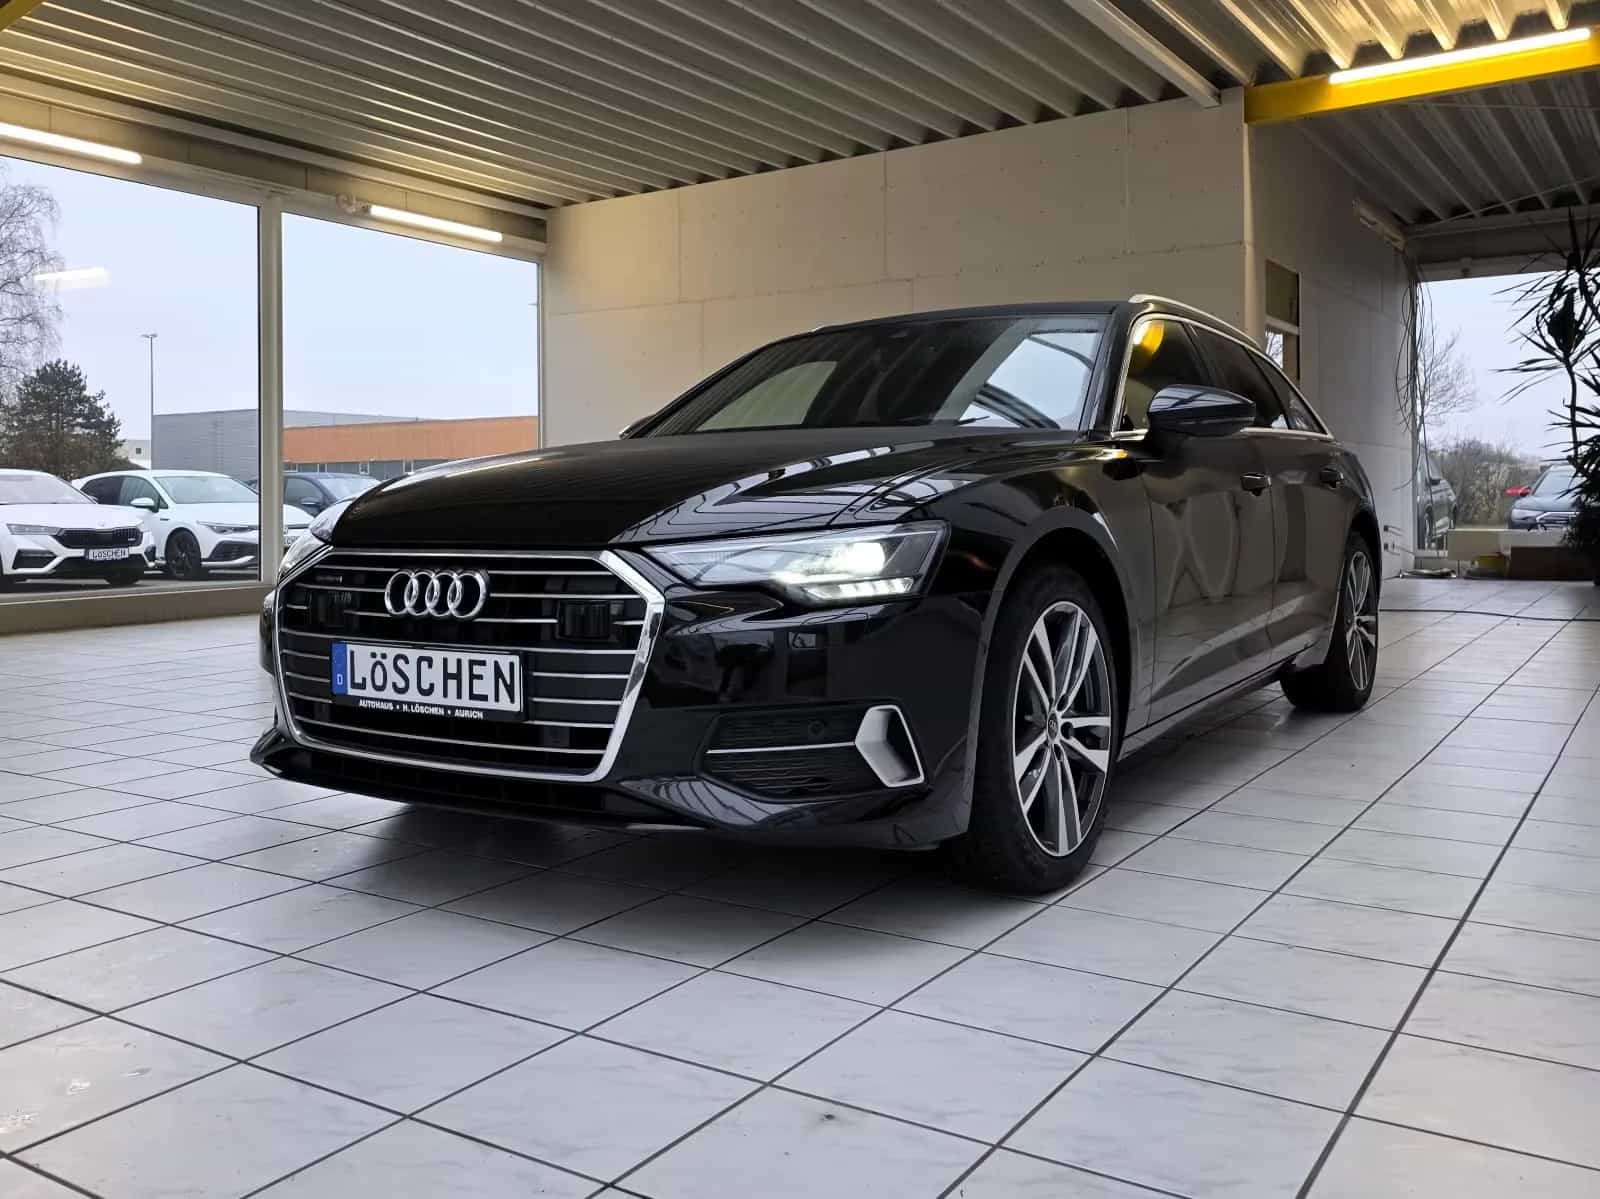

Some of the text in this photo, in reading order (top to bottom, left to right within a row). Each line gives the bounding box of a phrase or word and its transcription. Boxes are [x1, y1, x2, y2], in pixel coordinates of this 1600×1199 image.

[337, 651, 515, 704] D LÖSCHEN
[359, 699, 394, 710] AUTOHAUS
[454, 709, 484, 720] AURICH
